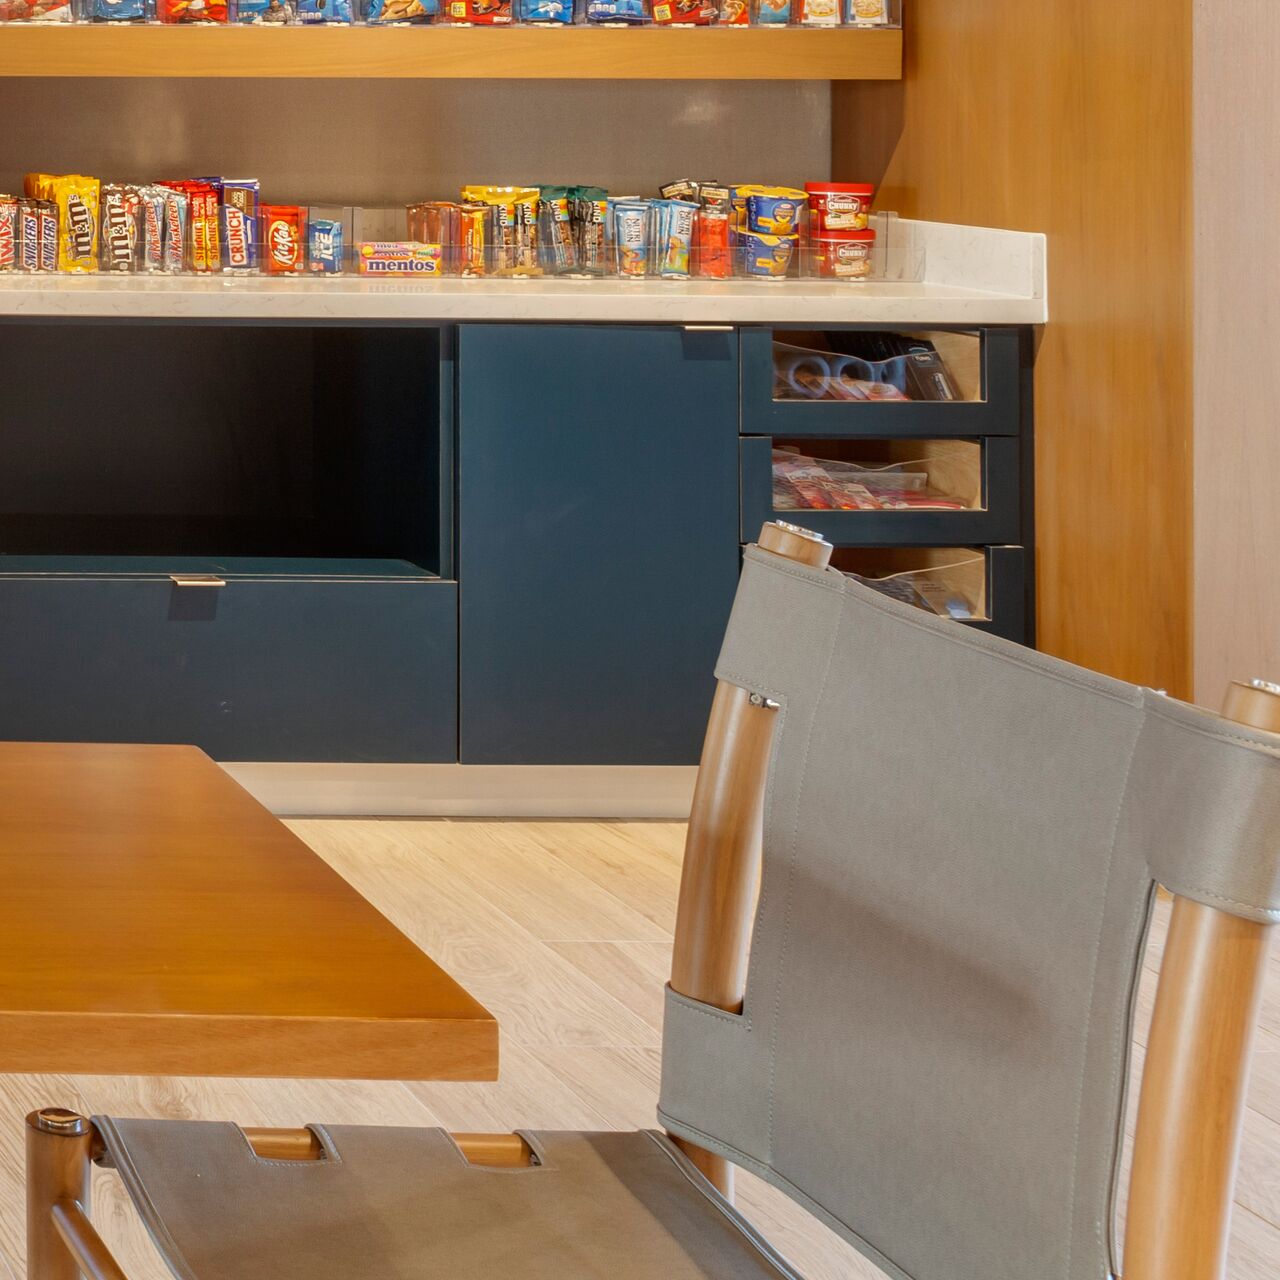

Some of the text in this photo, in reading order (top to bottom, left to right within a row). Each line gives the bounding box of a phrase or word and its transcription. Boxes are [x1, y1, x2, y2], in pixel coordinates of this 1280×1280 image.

[499, 204, 507, 225] KIND
[523, 202, 531, 224] KIND
[550, 200, 562, 221] KIND
[593, 201, 601, 223] KIND
[828, 202, 857, 210] CHUNKY
[146, 200, 161, 254] Musketeers
[168, 197, 182, 255] Musketeers
[227, 208, 246, 265] CRUNCH
[24, 215, 38, 270] SNICKERS
[42, 215, 56, 270] SNICKERS
[368, 260, 435, 271] mentos
